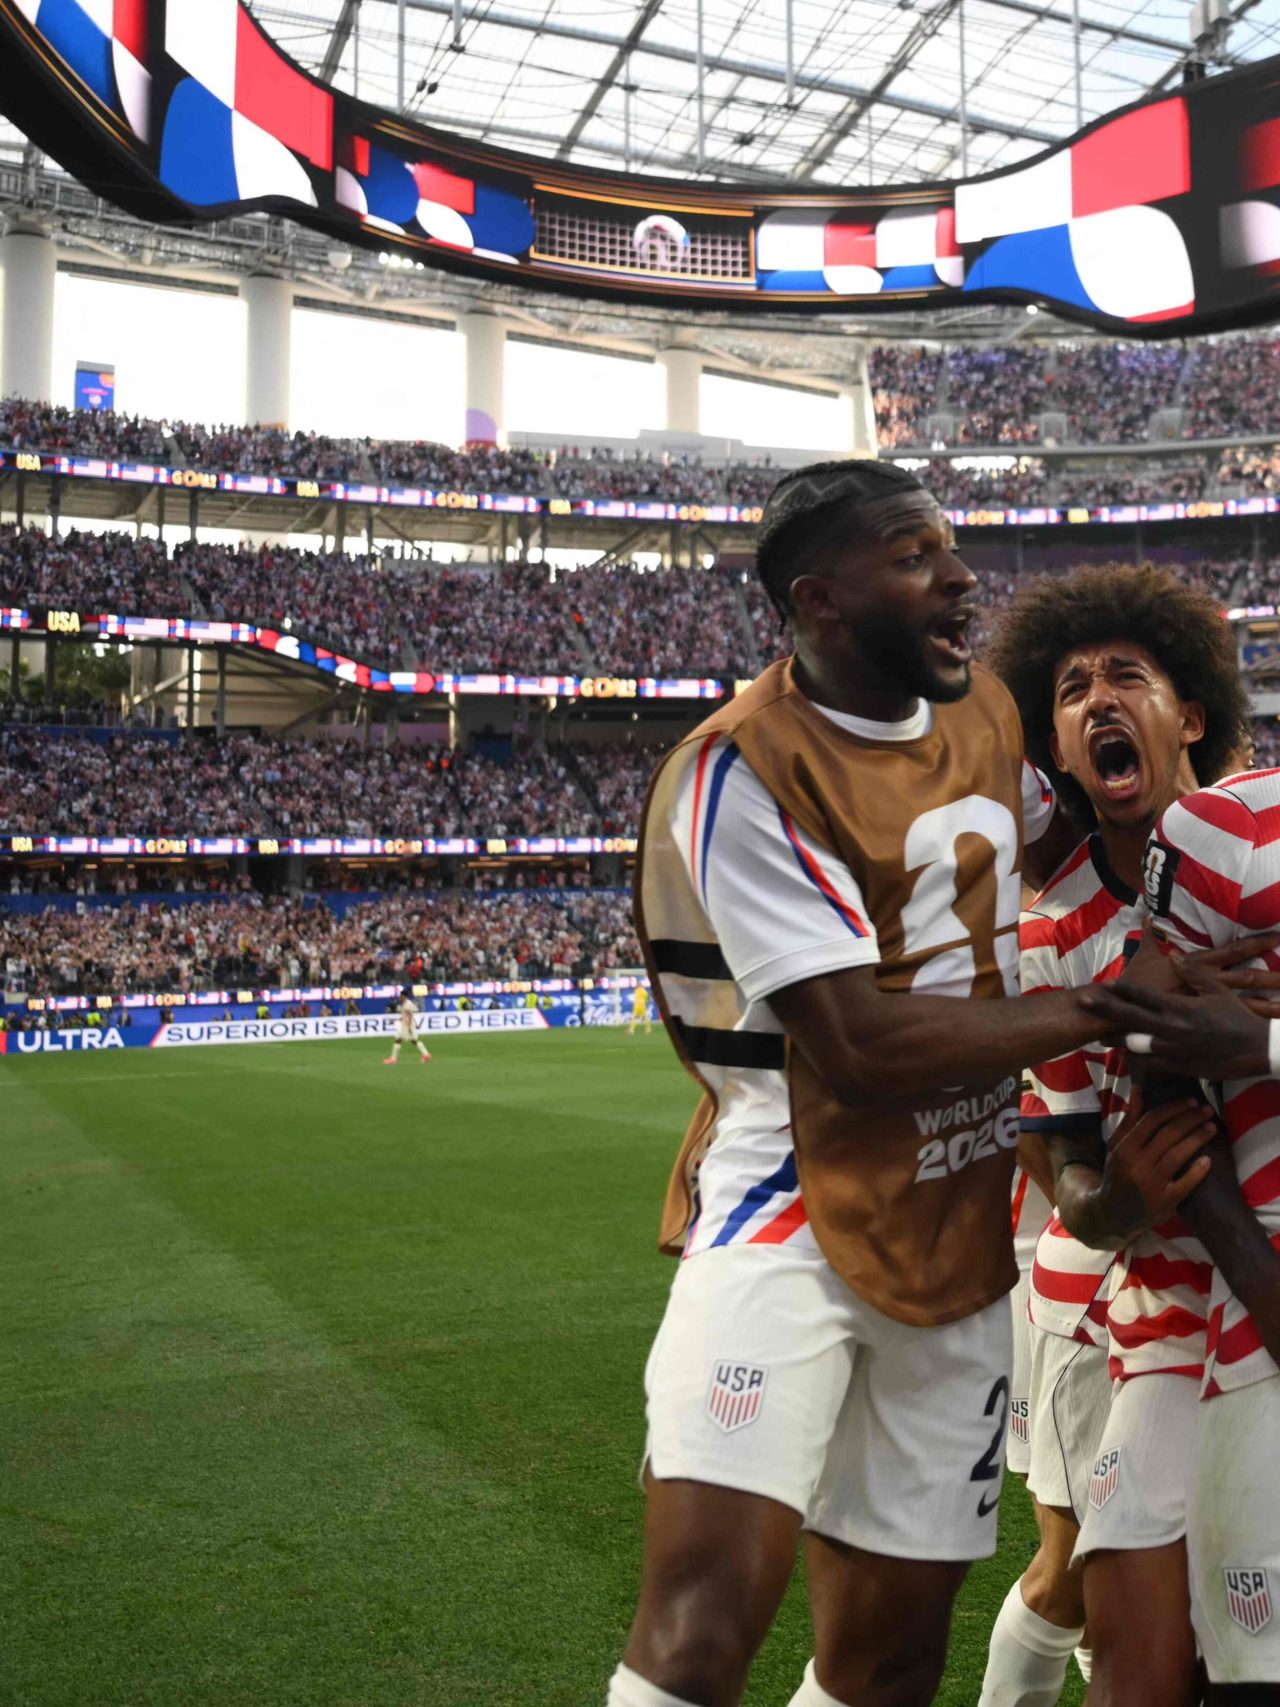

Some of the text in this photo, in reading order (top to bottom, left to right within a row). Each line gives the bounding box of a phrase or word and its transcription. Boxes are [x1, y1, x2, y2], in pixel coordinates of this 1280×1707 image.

[16, 454, 41, 471] USA
[47, 610, 80, 633] USA
[11, 836, 33, 852] USA
[17, 1027, 125, 1054] ULTRA
[166, 1018, 309, 1044] SUPERIOR
[315, 1016, 338, 1036] IS
[468, 1010, 535, 1029] HERE
[912, 1075, 1017, 1137] WORLD CUP
[914, 1107, 1021, 1184] 2026
[717, 1364, 764, 1393] USA
[1094, 1450, 1119, 1477] USA
[1227, 1570, 1265, 1597] USA
